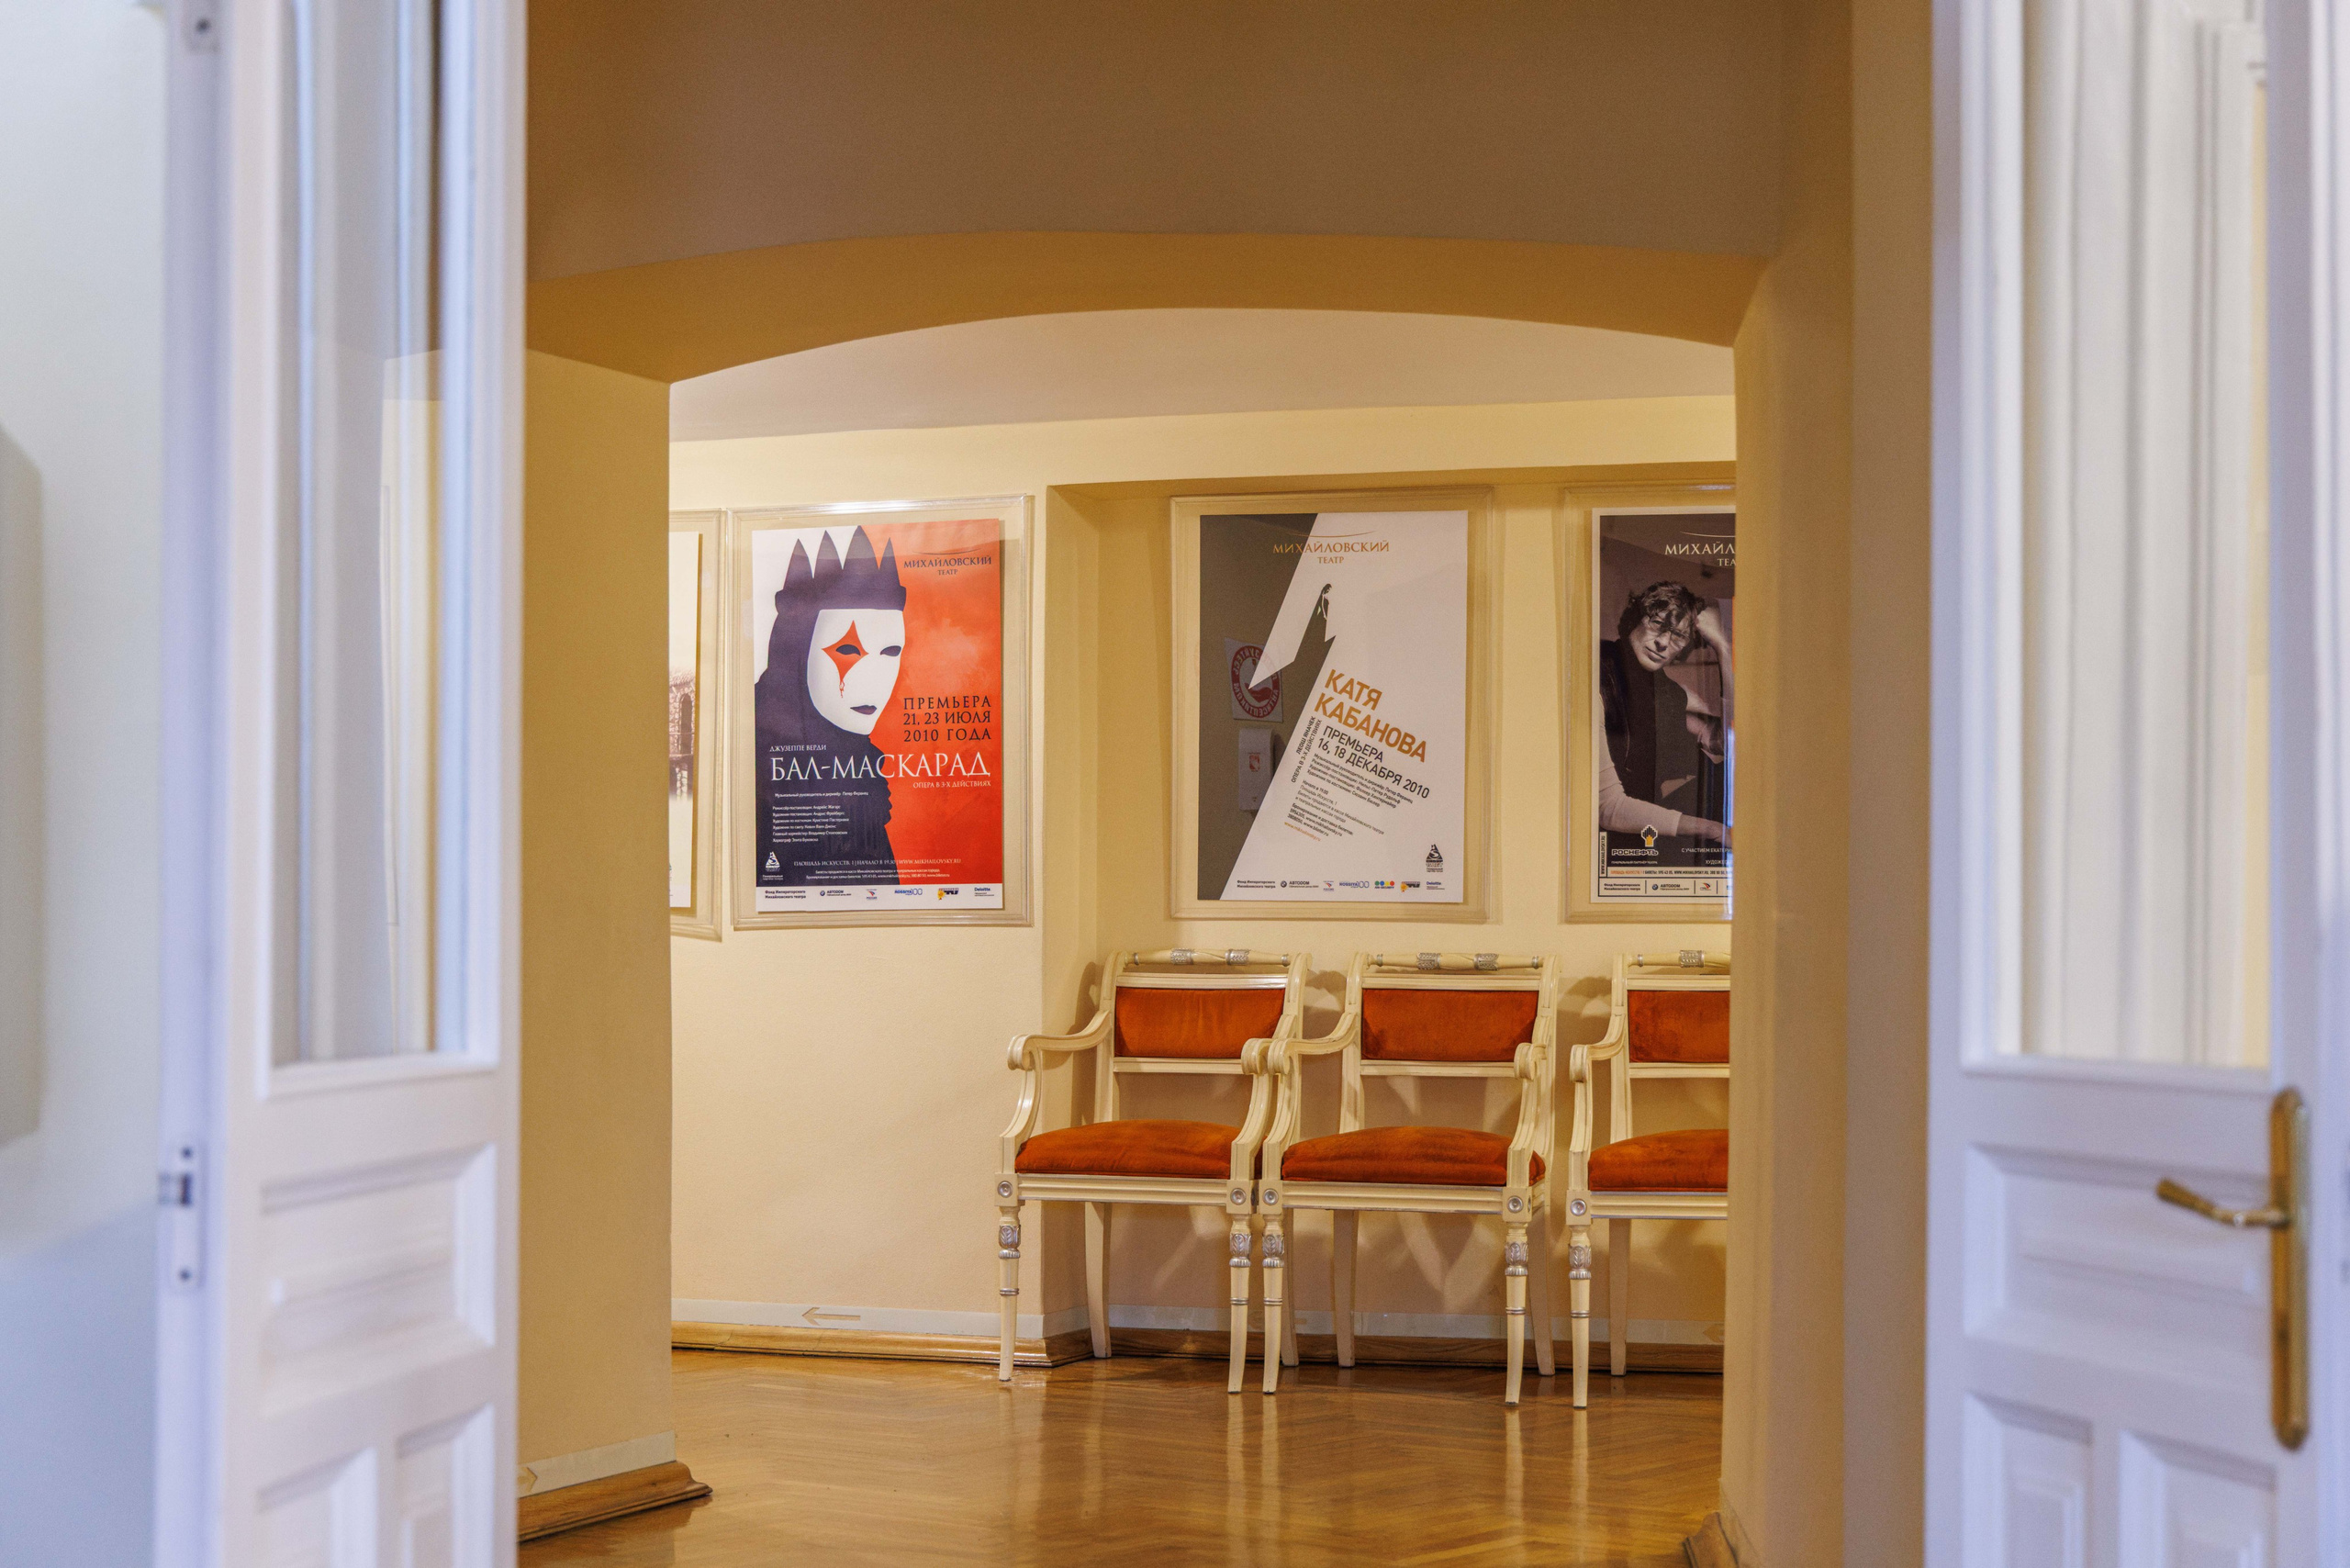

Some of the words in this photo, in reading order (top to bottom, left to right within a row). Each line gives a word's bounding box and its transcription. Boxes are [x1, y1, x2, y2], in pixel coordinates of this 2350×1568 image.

[1273, 540, 1389, 554] МИХАЙЛОВСКИЙ
[903, 554, 991, 568] МИХАЙЛОВСКИЙ
[1325, 669, 1382, 711] КАТЯ
[903, 695, 991, 710] ПРЕМЬЕРА
[903, 712, 921, 725] 21,
[924, 712, 939, 725] 23
[945, 711, 990, 723] ИЮЛЯ
[1315, 693, 1426, 762] КАБАНОВА
[904, 729, 939, 743] 2010
[947, 728, 991, 741] ГОДА
[1296, 738, 1305, 755] ЛЕОШ
[1304, 716, 1315, 737] ЯНАЧЕК
[1324, 726, 1382, 762] ПРЕМЬЕРА
[1292, 766, 1302, 782] ОПЕРА
[1305, 720, 1322, 752] ДЕЙСТВИЯХ
[770, 752, 991, 781] БАЛ-МАСКАРАД
[1317, 737, 1329, 754] 16,
[1335, 745, 1346, 758] 18
[1346, 753, 1403, 786] ДЕКАБРЯ
[1403, 779, 1429, 798] 2010
[952, 779, 991, 788] ДЕЙСТВИЯХ
[1611, 848, 1659, 857] РОСНЕФТЬ
